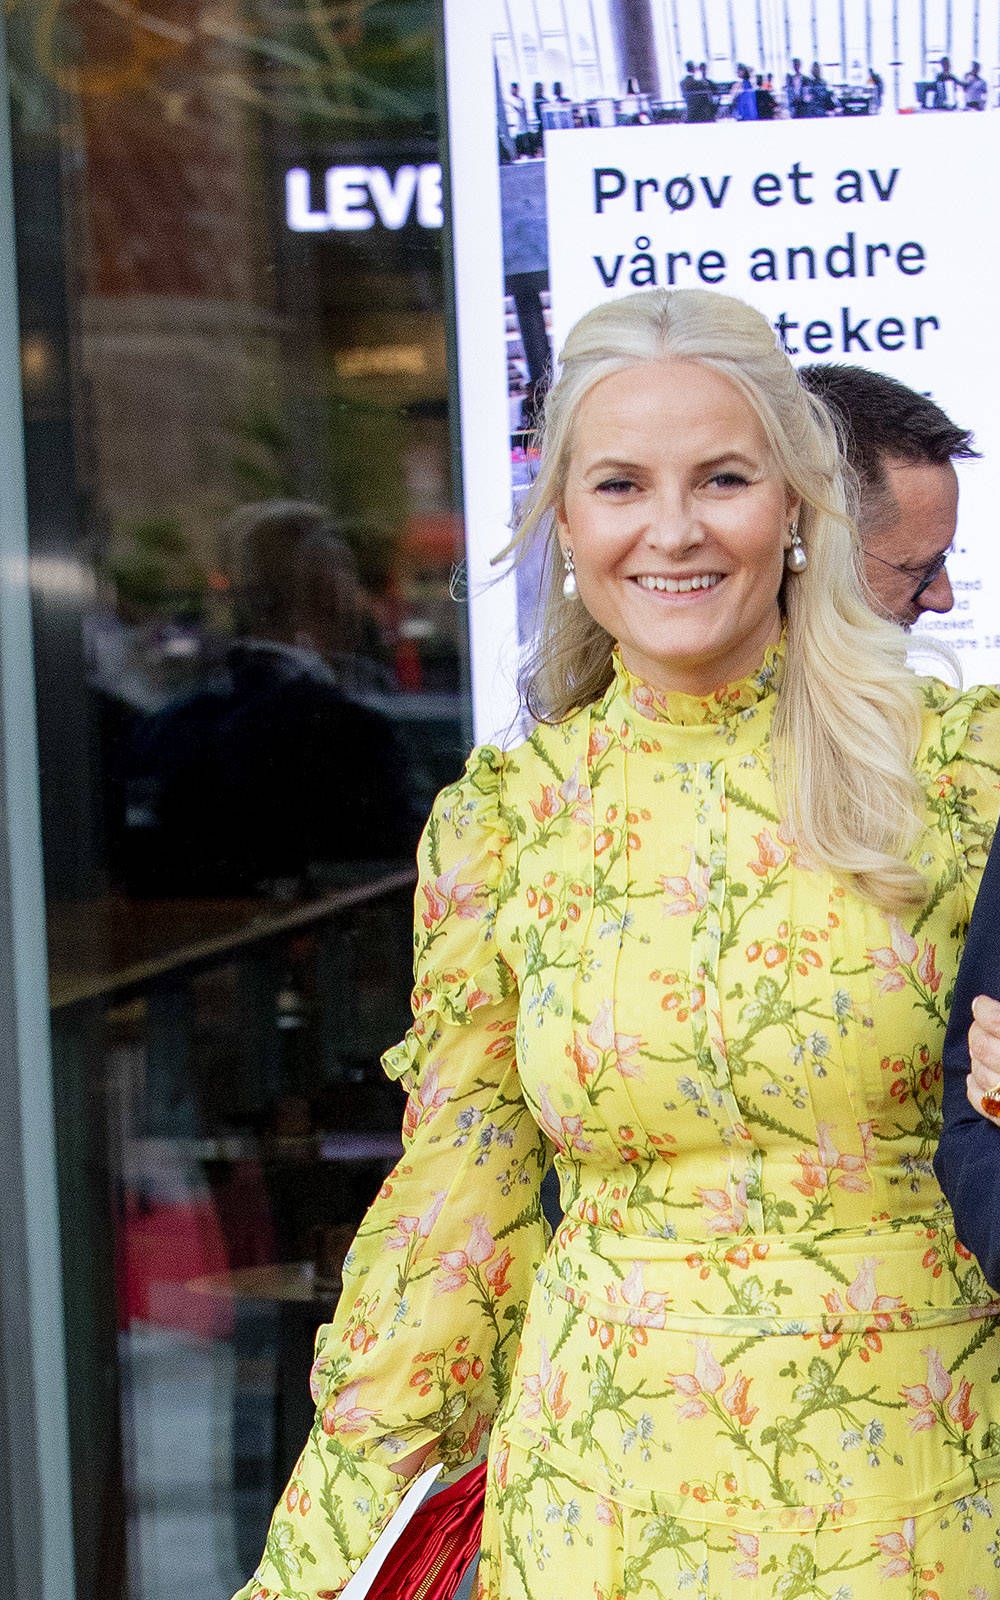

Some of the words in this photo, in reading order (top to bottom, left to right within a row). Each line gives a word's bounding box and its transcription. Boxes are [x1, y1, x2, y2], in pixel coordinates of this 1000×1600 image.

[592, 167, 732, 214] Prøv
[752, 162, 814, 207] et
[835, 168, 901, 205] av
[593, 235, 727, 289] våre
[749, 231, 928, 282] andre
